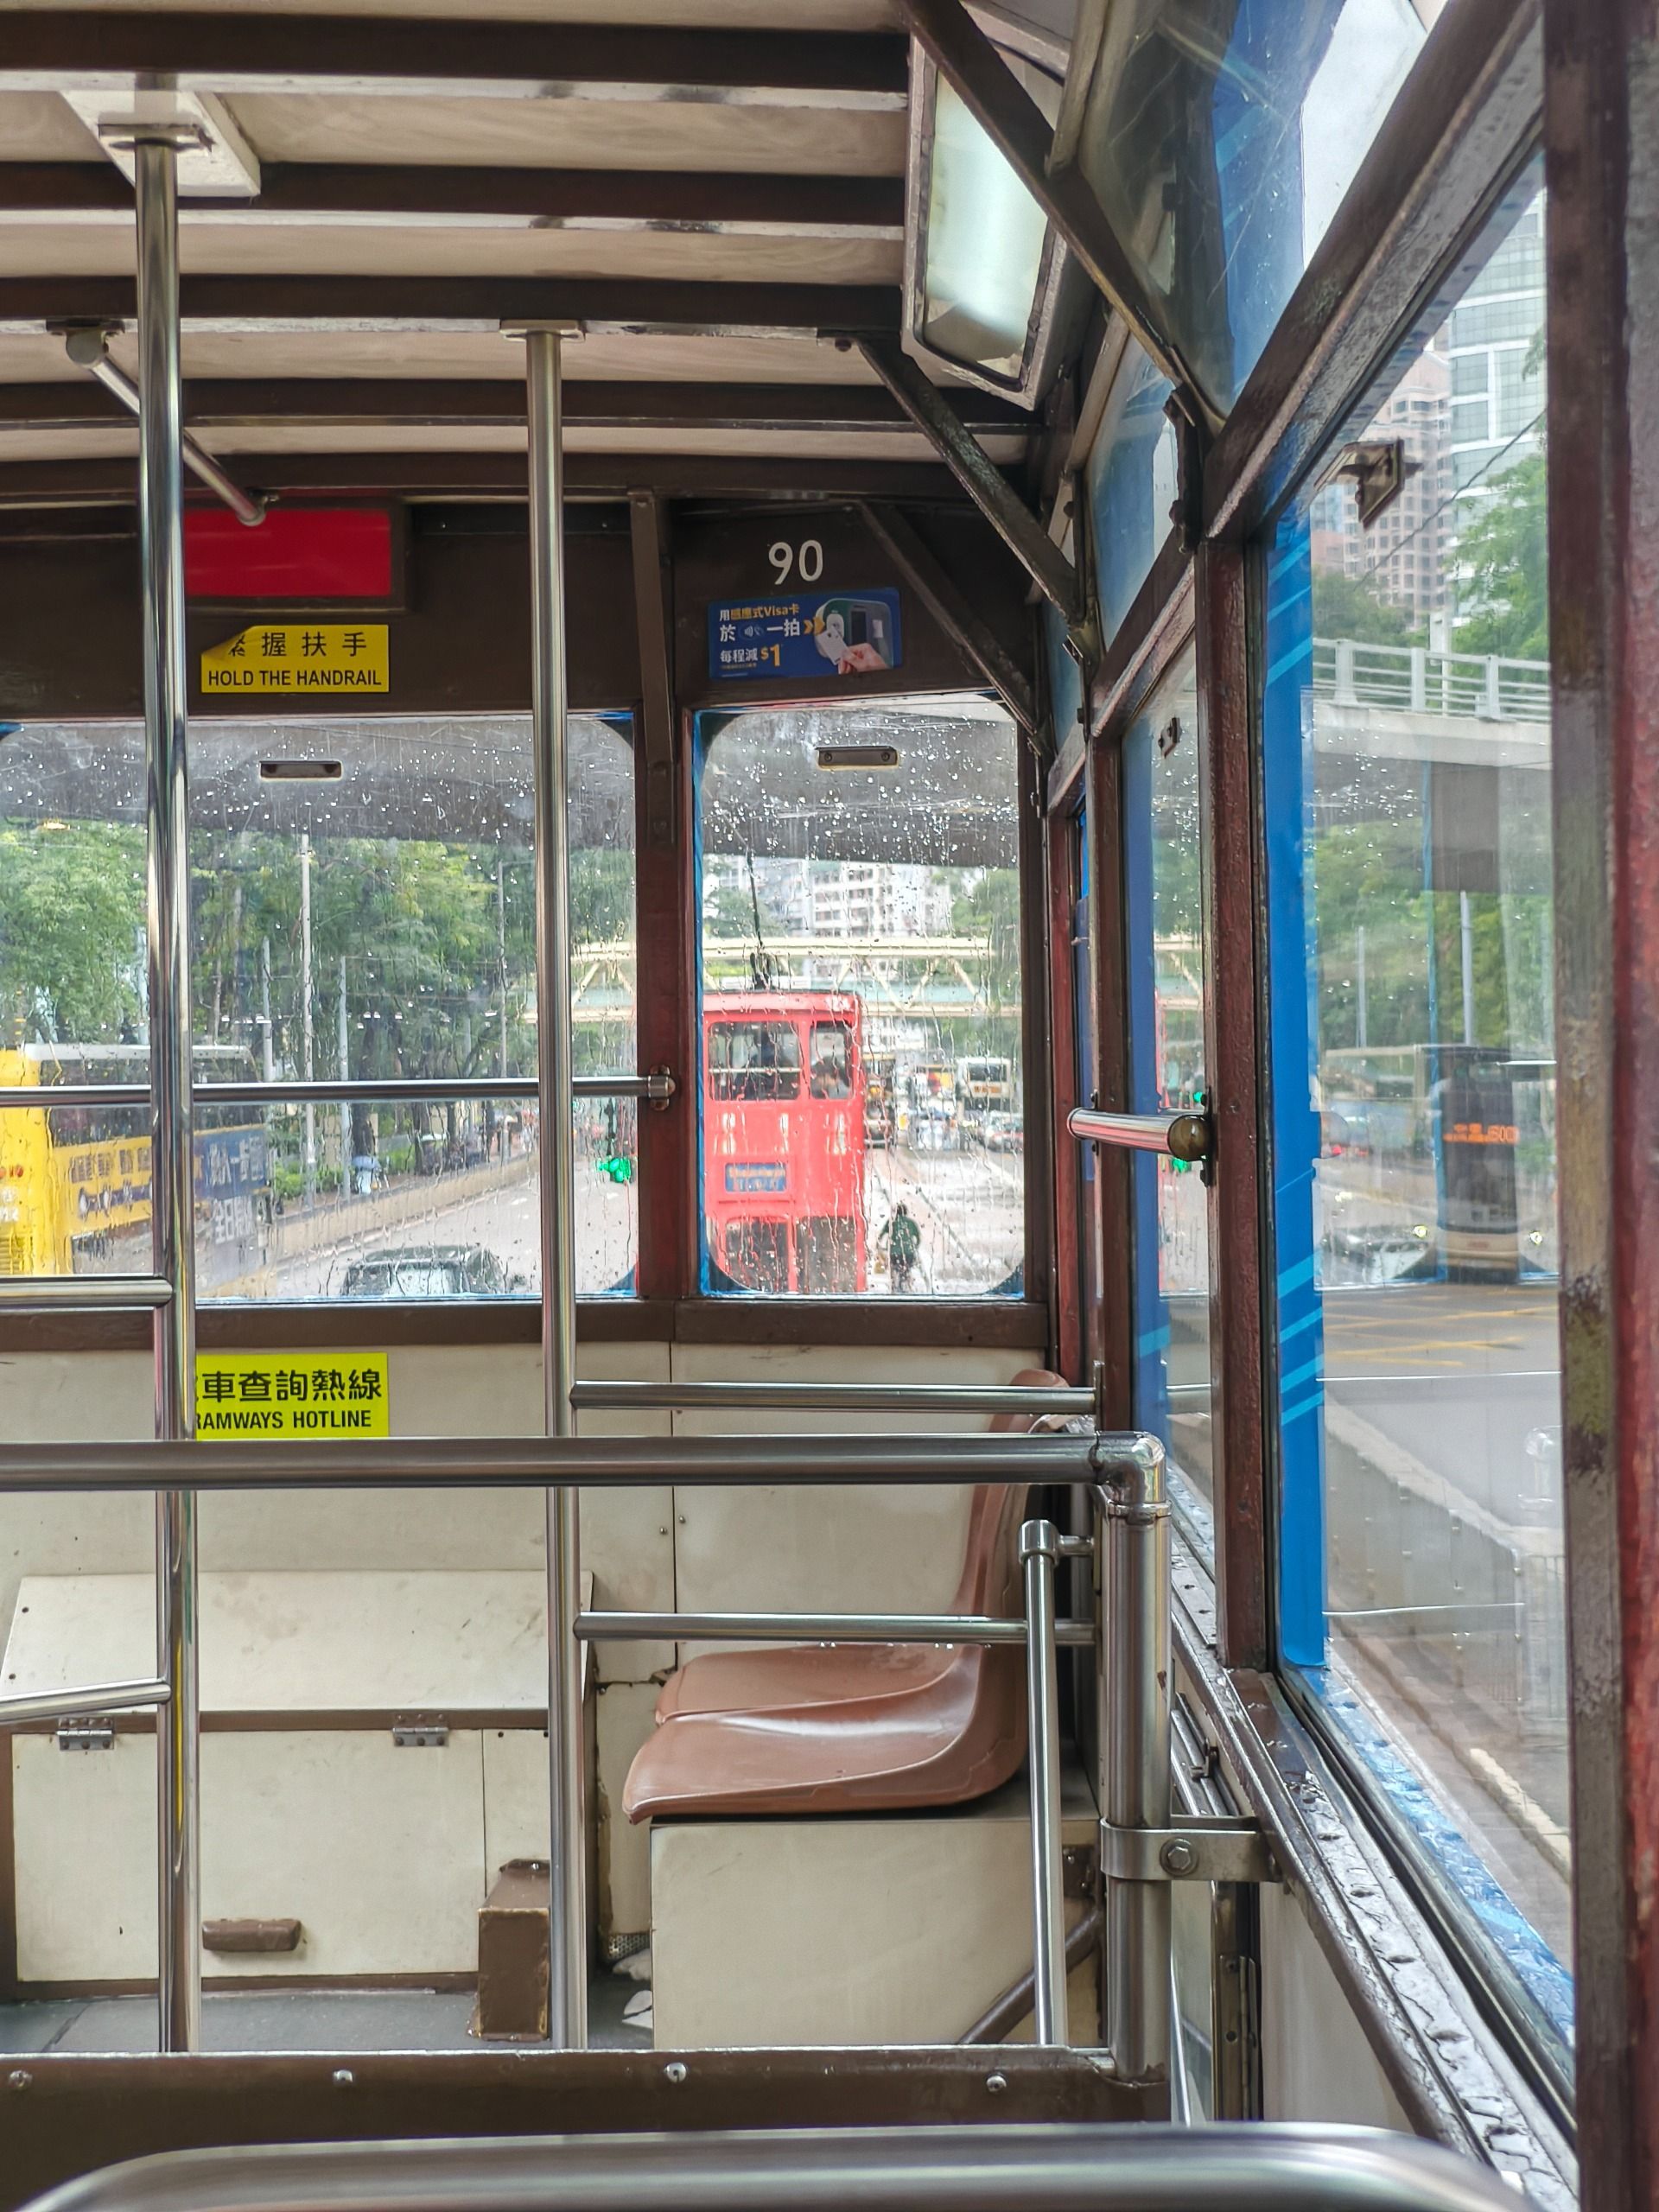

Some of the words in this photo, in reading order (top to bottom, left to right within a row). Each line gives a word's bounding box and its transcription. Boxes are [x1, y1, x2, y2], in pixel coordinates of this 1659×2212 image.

[768, 539, 823, 585] 90
[766, 618, 800, 637] 一拍
[208, 671, 253, 686] HOLD
[259, 671, 291, 685] THE
[296, 670, 382, 685] HANDRAIL
[196, 1369, 382, 1403] 車查詢熱線
[293, 1409, 372, 1429] HOTLINE
